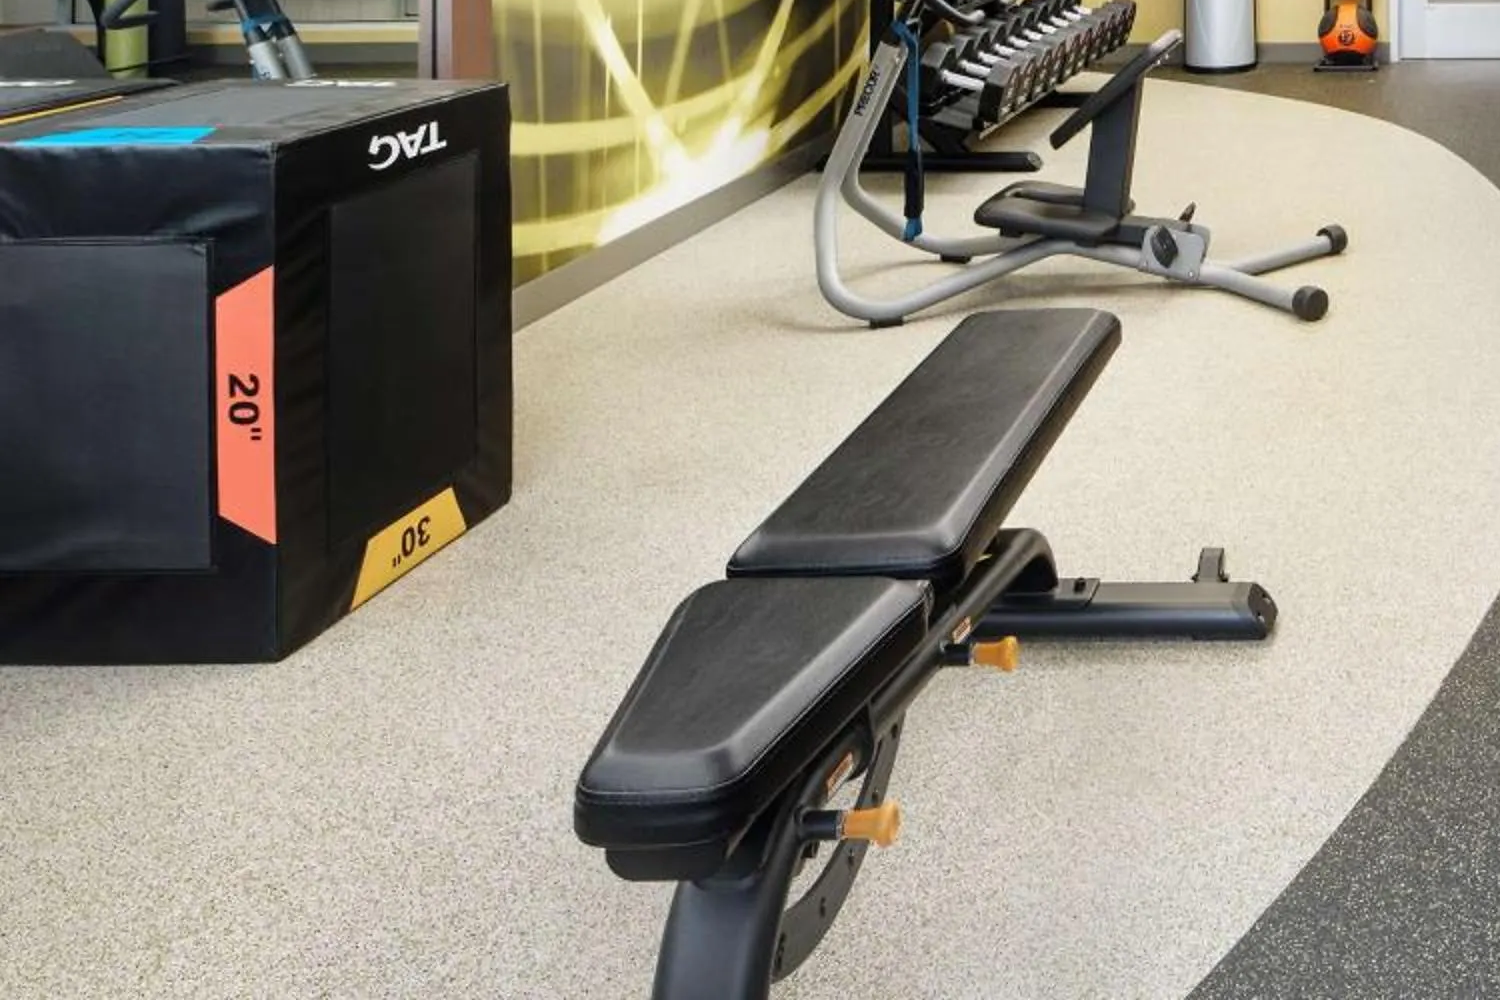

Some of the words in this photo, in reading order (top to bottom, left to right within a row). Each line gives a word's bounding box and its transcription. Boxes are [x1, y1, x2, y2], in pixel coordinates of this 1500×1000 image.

[368, 121, 447, 170] TAG
[229, 373, 262, 441] 20"
[393, 516, 431, 567] 30"
